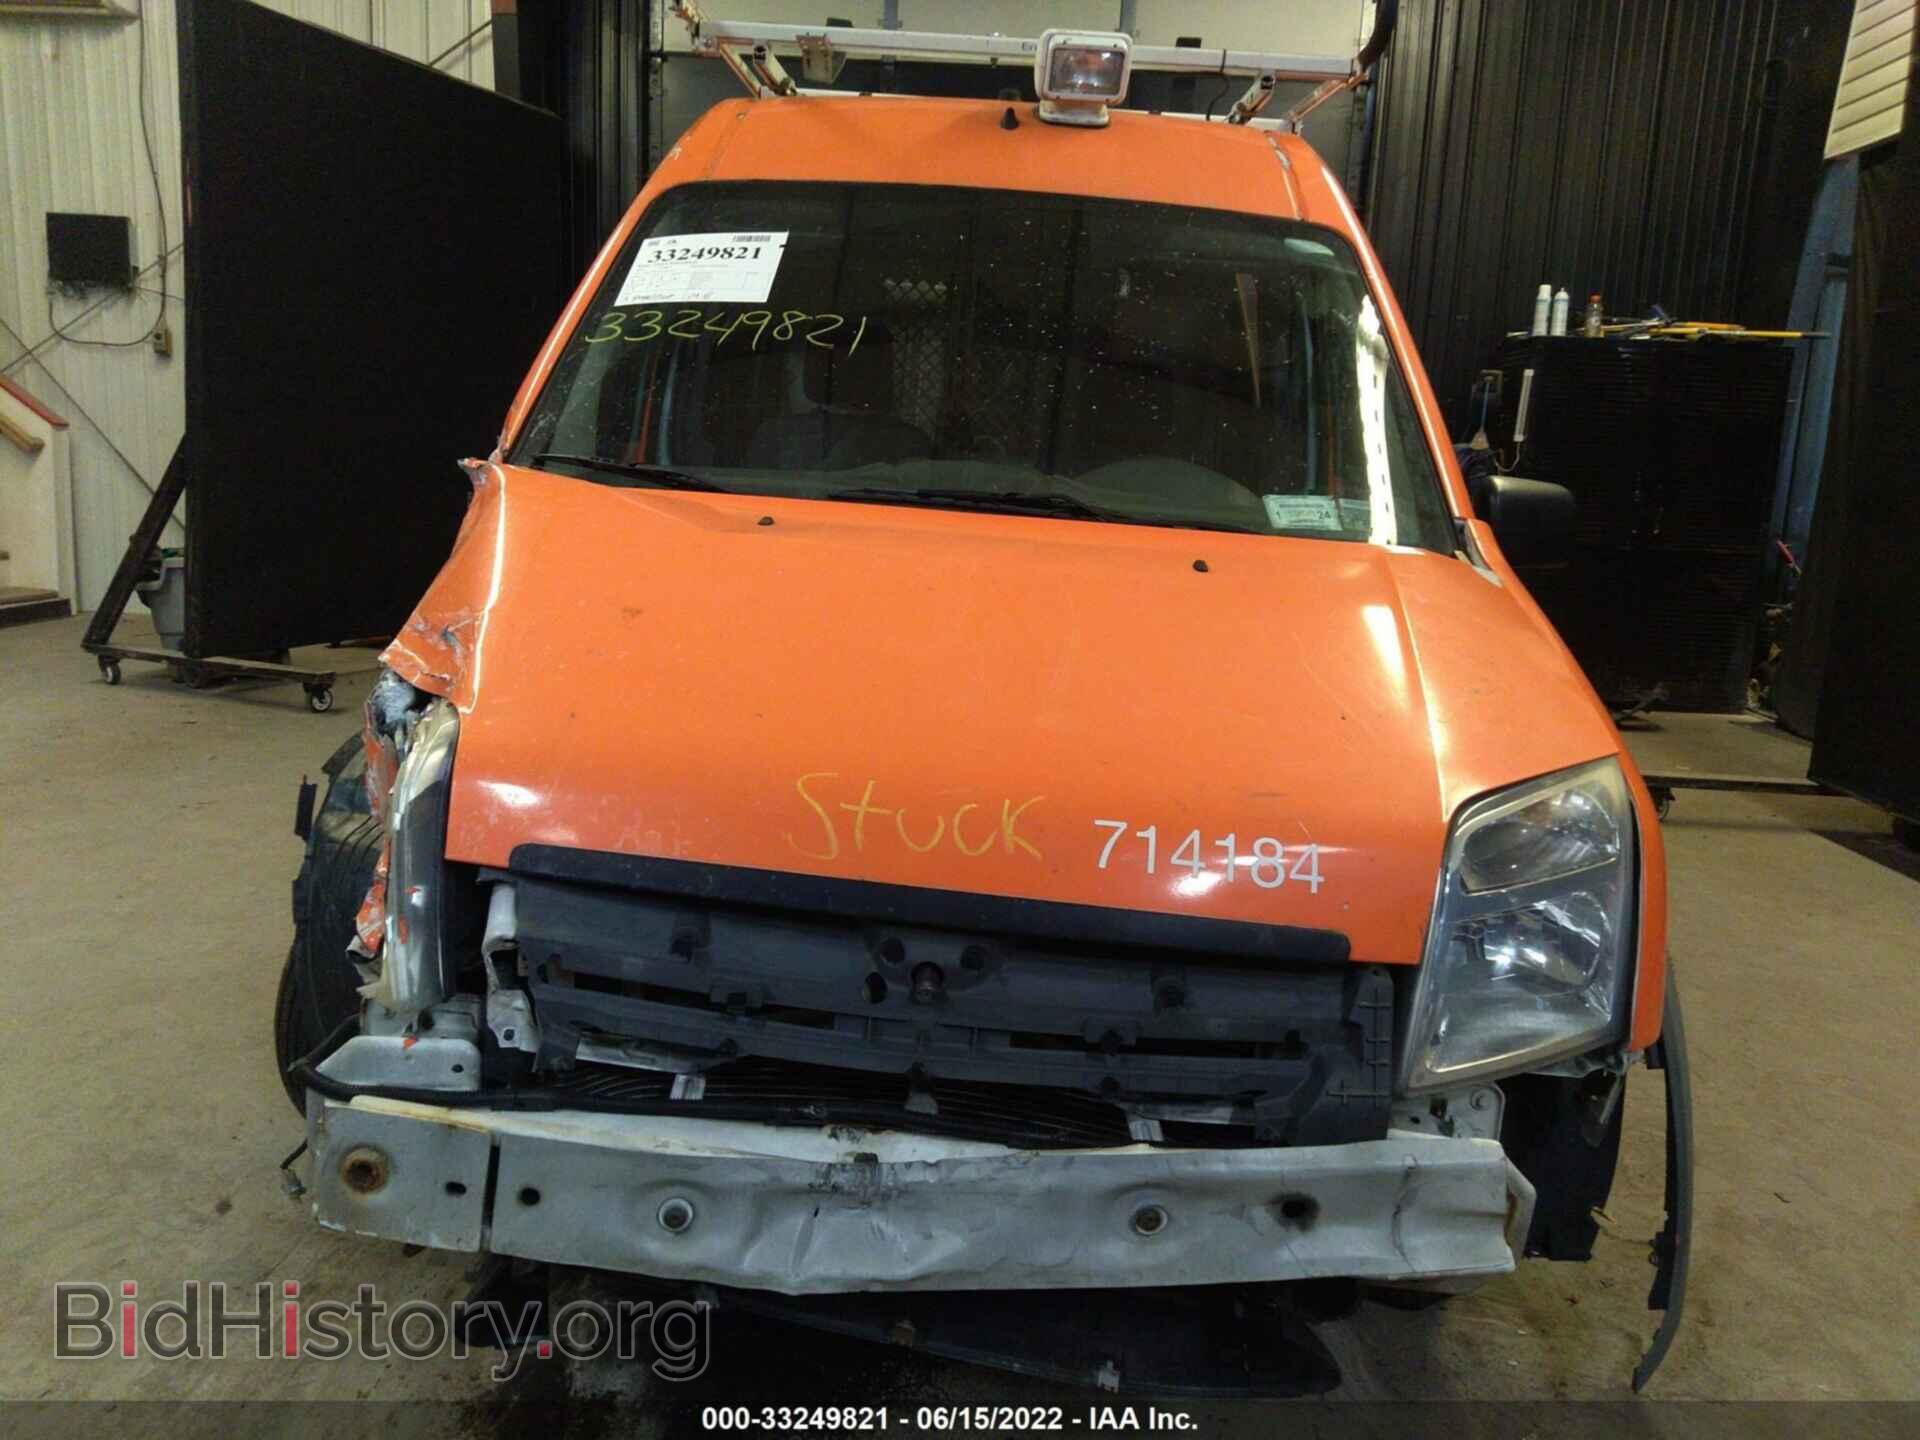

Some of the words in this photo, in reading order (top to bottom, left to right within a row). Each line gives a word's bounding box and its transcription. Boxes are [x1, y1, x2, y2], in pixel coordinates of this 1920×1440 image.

[647, 246, 761, 263] 33249821
[585, 309, 868, 357] 33249821
[1093, 818, 1325, 894] 714184
